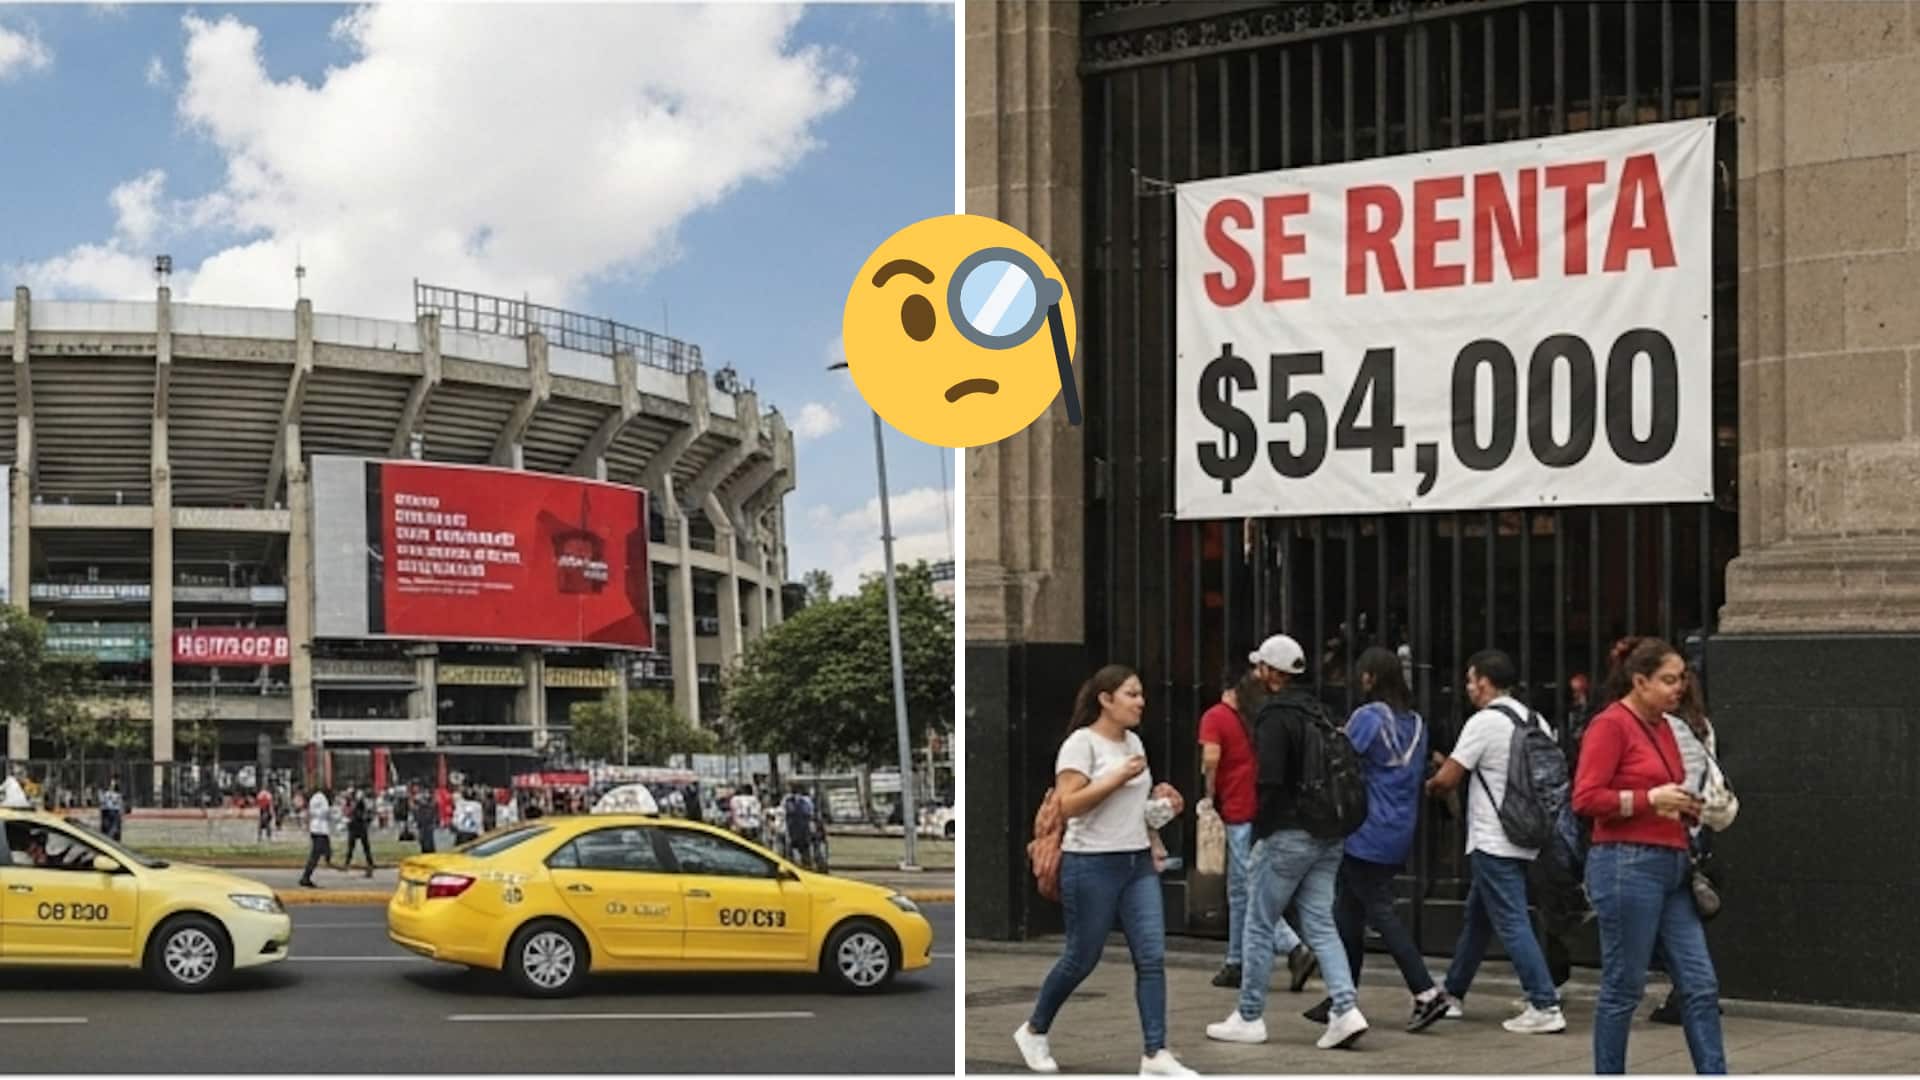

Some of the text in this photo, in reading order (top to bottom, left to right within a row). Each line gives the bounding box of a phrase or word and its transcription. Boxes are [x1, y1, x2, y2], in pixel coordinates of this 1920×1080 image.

[1204, 152, 1678, 308] SE RENTA
[1196, 328, 1679, 497] $54,000
